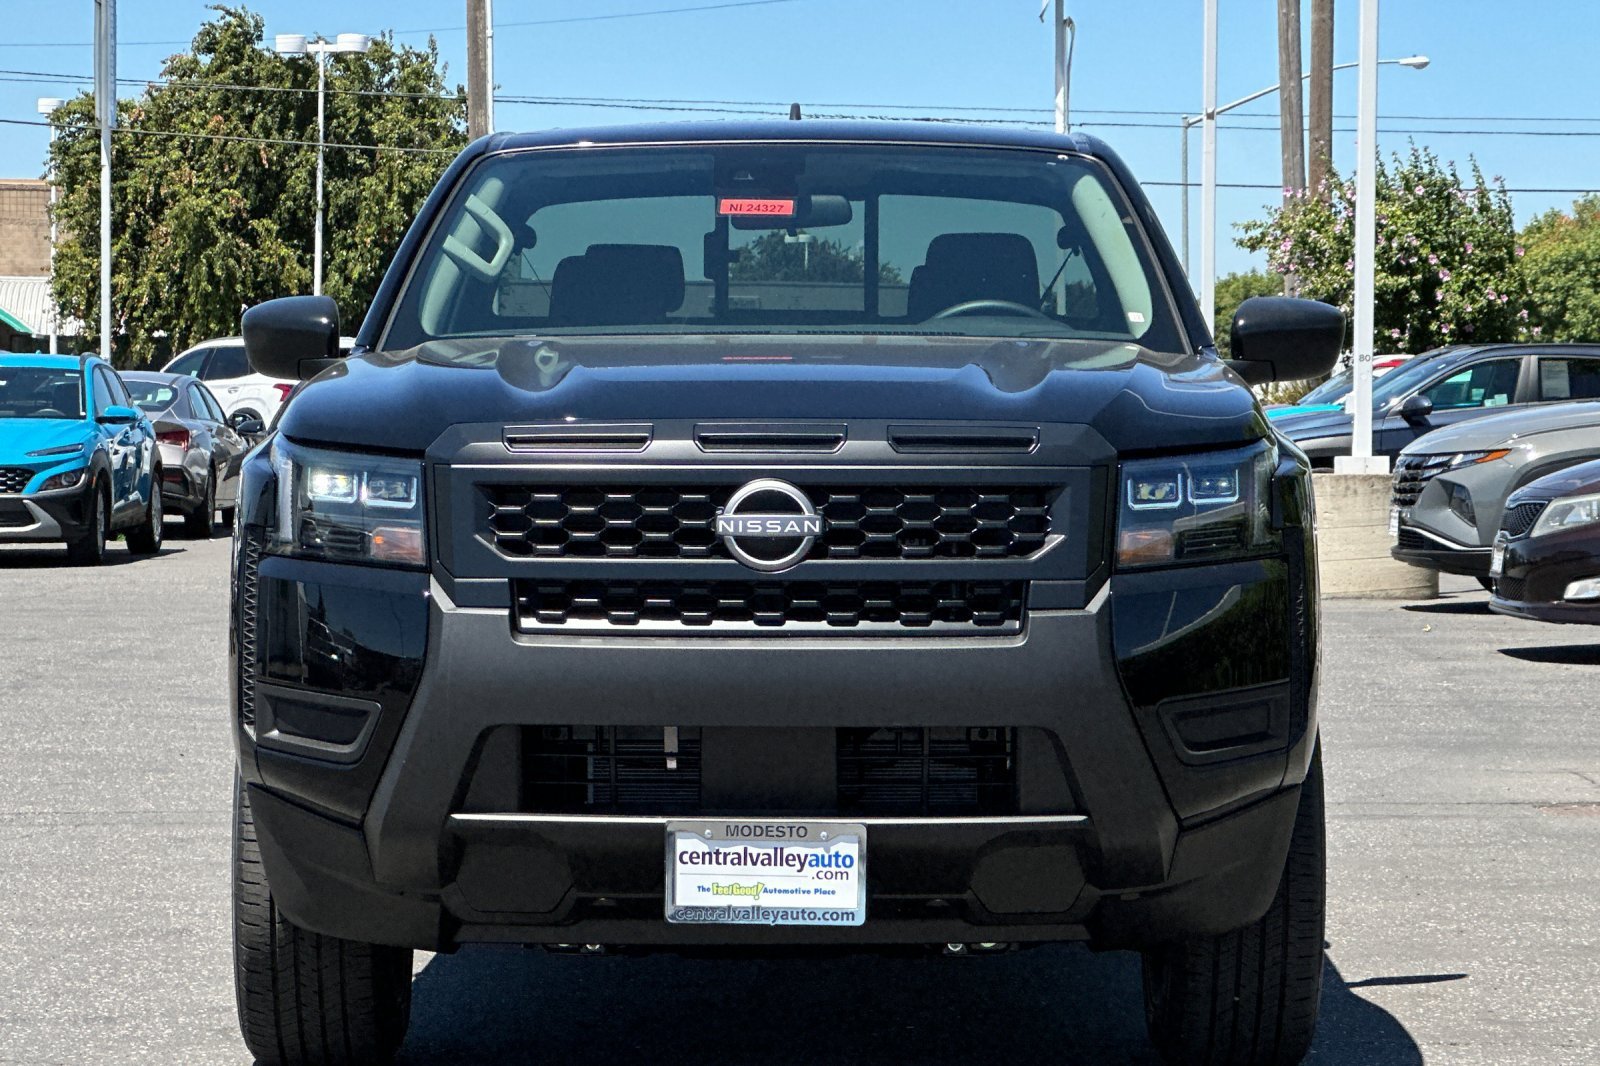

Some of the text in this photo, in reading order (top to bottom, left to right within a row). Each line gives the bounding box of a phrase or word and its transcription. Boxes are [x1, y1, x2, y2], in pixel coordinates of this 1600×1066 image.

[729, 203, 785, 213] NI 24327
[718, 519, 820, 533] NISSAN
[725, 824, 808, 838] MODESTO
[678, 846, 855, 872] centralvalleyauto
[811, 869, 849, 881] .com
[697, 885, 711, 893] The
[762, 887, 811, 895] Automotive
[676, 905, 855, 924] centralvalleyauto.com
